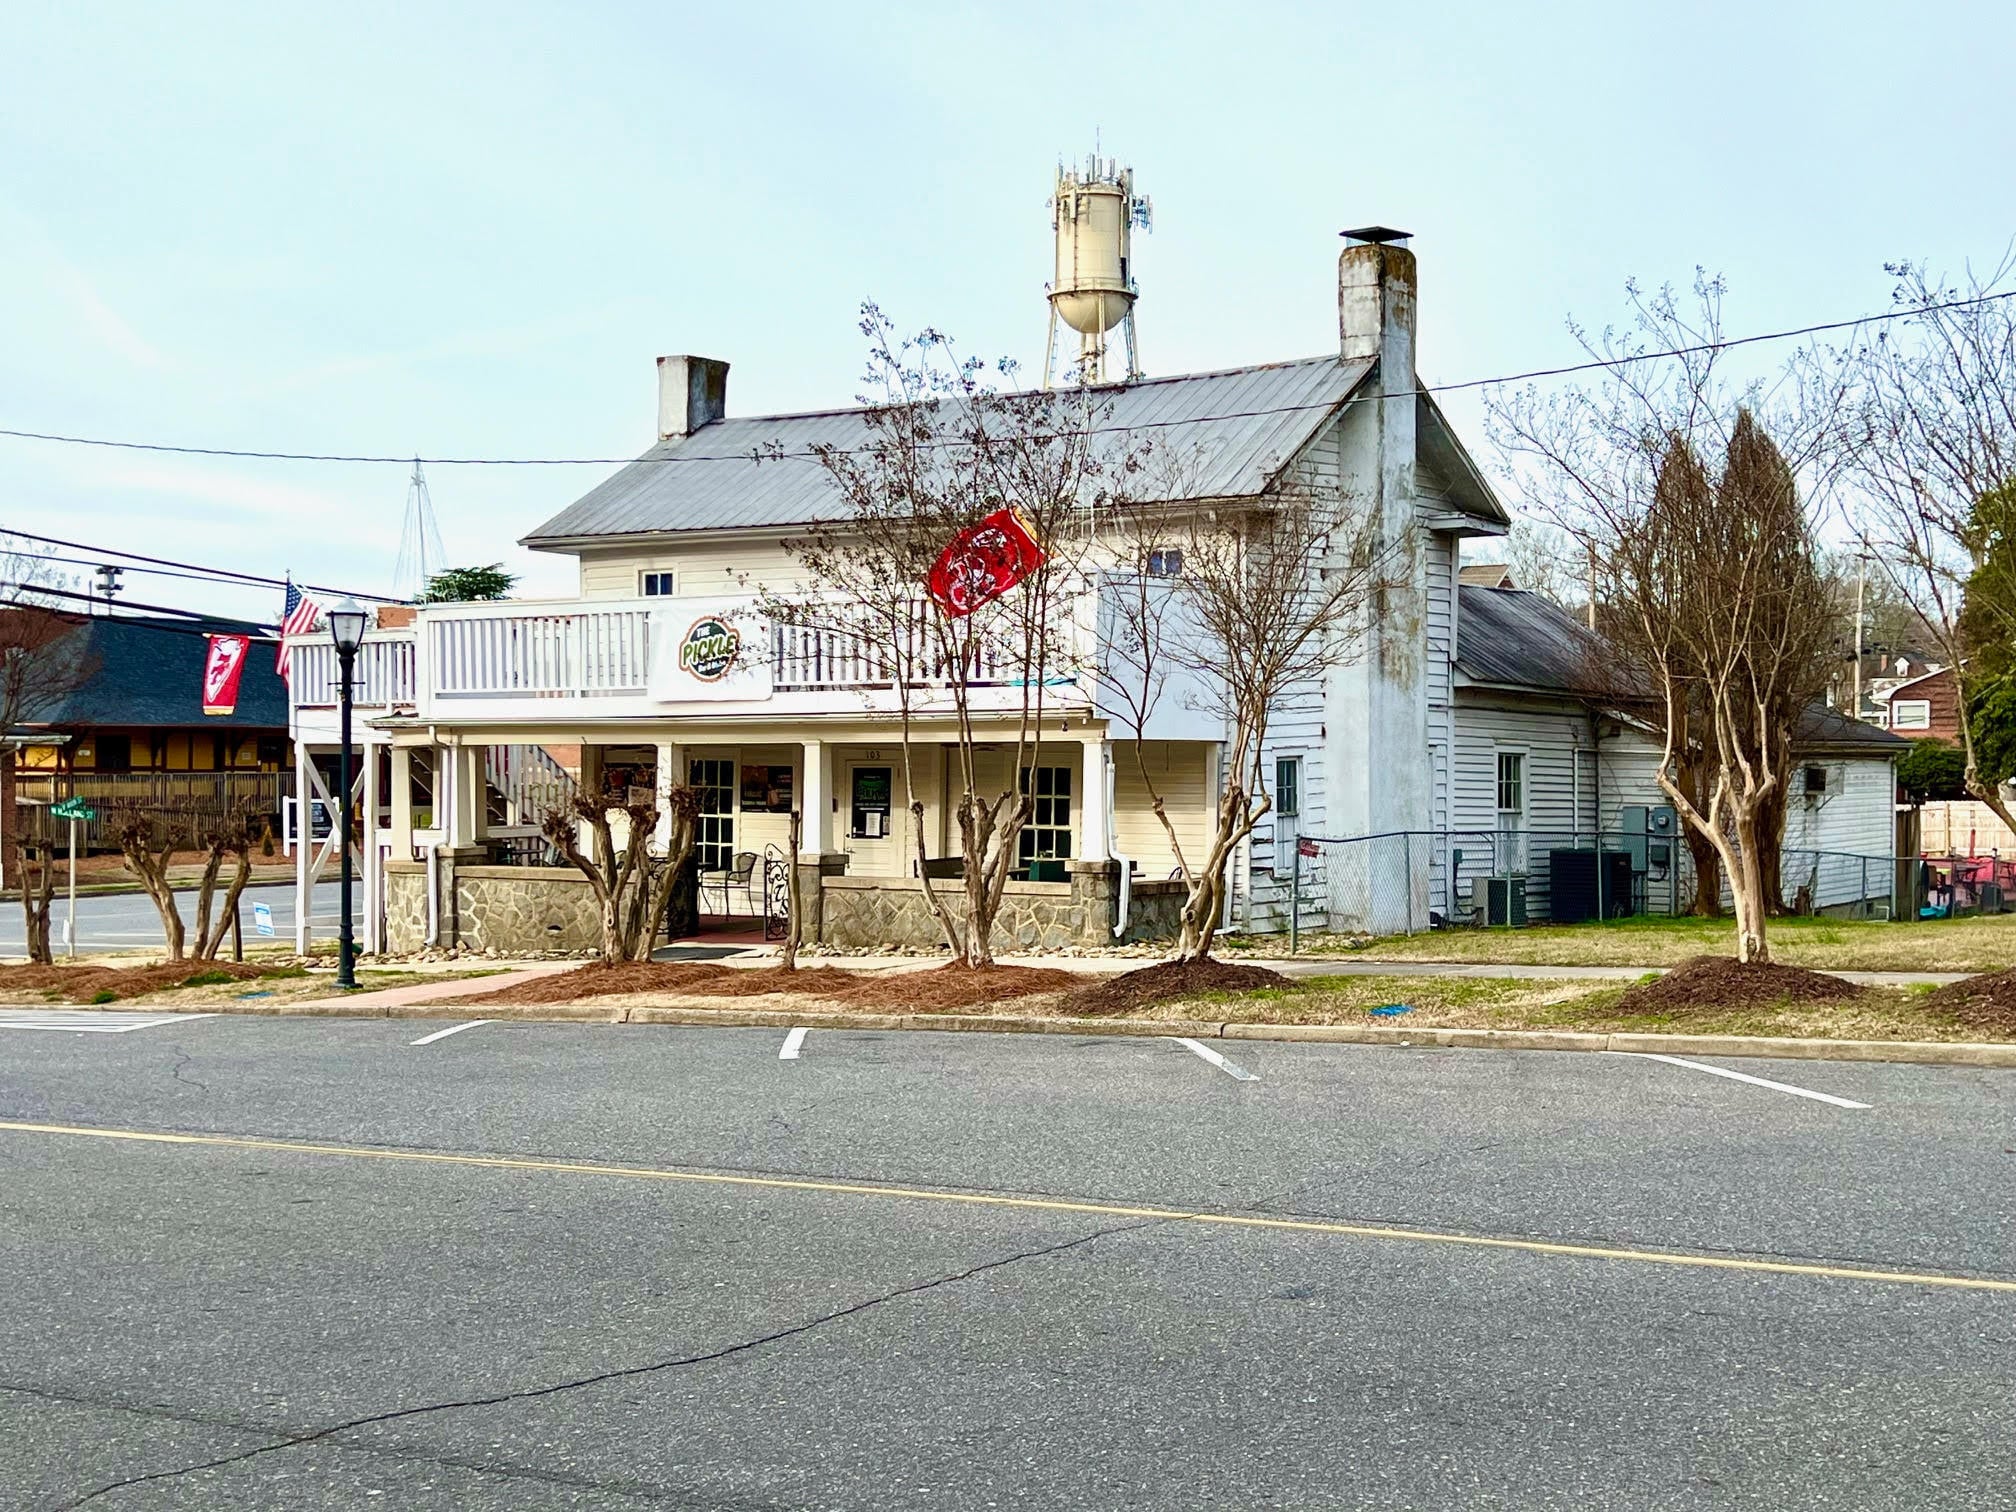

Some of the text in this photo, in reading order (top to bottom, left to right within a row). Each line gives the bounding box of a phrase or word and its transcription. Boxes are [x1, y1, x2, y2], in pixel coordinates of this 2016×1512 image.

[697, 626, 710, 638] THE
[683, 634, 736, 666] PICKLE
[865, 751, 881, 760] 103
